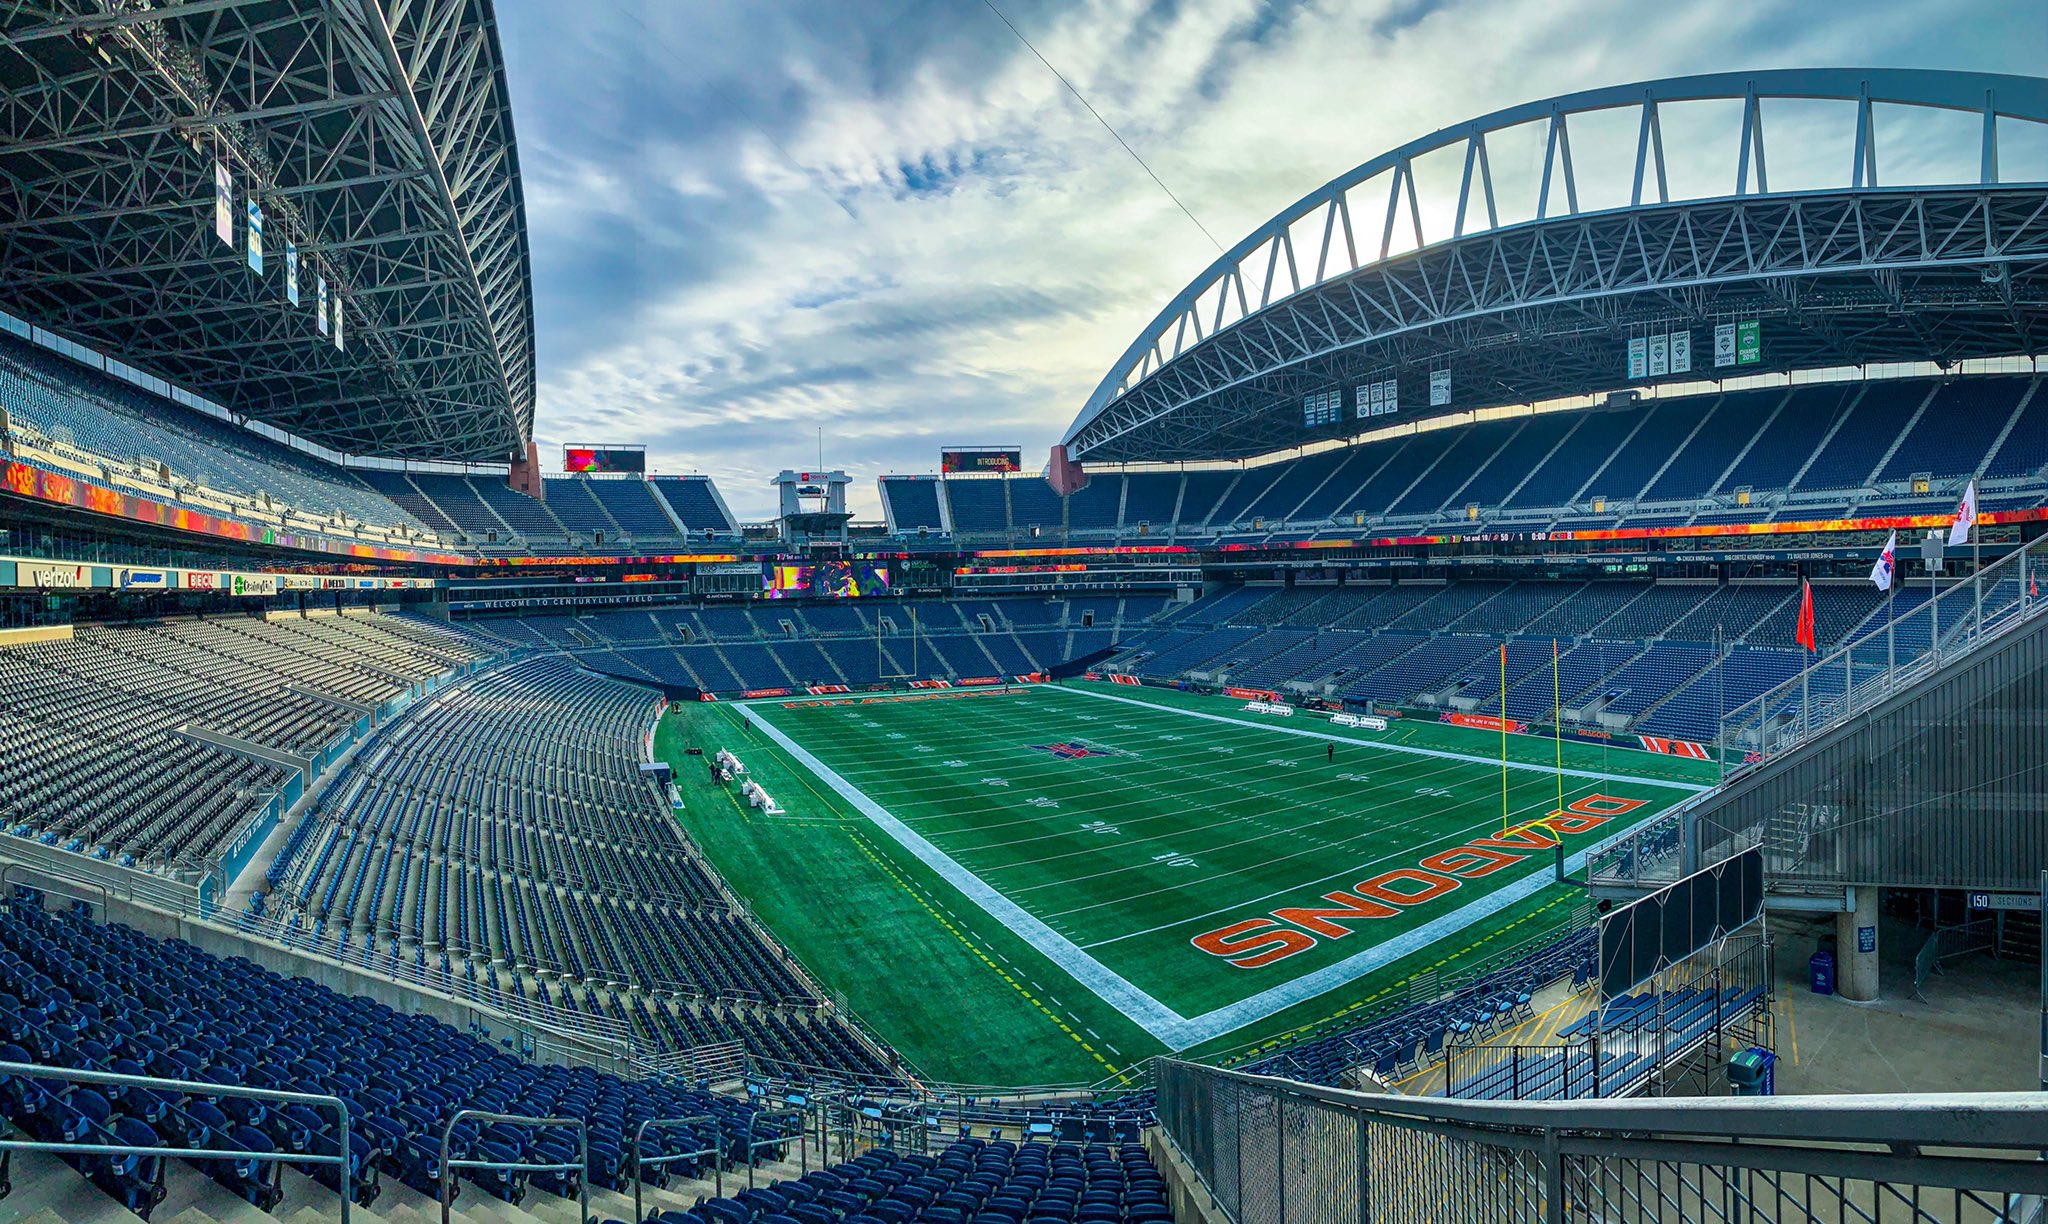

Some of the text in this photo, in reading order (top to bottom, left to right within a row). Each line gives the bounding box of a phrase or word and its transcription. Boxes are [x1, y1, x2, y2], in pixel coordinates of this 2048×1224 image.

[977, 457, 1010, 466] INTRODUCING
[1500, 533, 1509, 541] 50
[1531, 532, 1546, 540] 0:00
[33, 566, 77, 588] verizon
[190, 574, 214, 587] BECU
[328, 579, 346, 588] DELTA
[484, 600, 531, 608] WELCOME
[553, 597, 621, 605] CENTURYLINK
[1578, 728, 1611, 739] DRAGONS
[1190, 793, 1652, 969] DRAGONS
[1973, 895, 2033, 907] 150 SECTIONS
